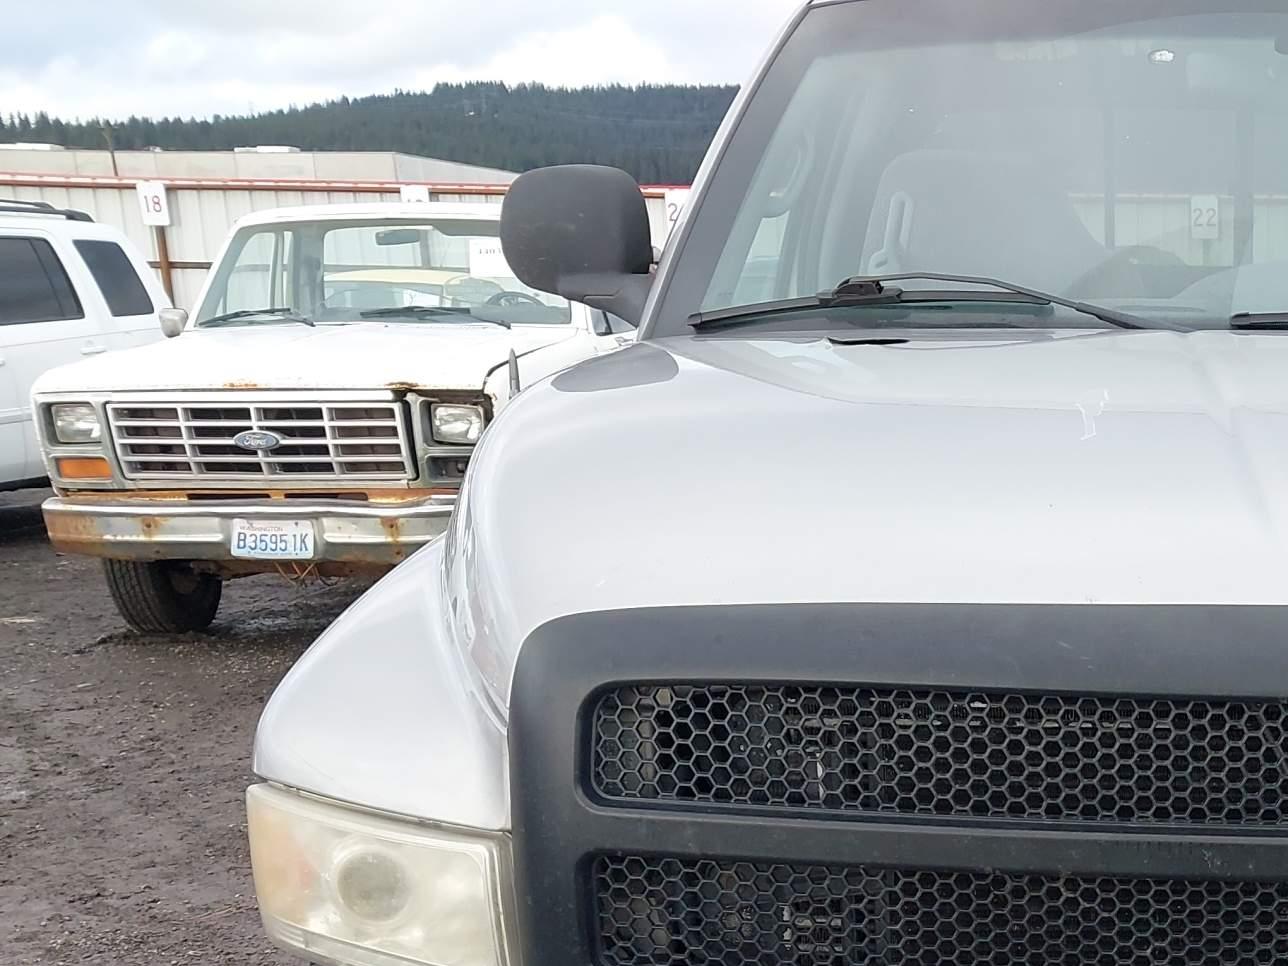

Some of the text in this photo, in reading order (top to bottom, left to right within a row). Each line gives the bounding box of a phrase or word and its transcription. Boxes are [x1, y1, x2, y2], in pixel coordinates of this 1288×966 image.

[143, 195, 162, 213] 18
[1192, 208, 1217, 227] 22
[237, 532, 309, 552] B35951K
